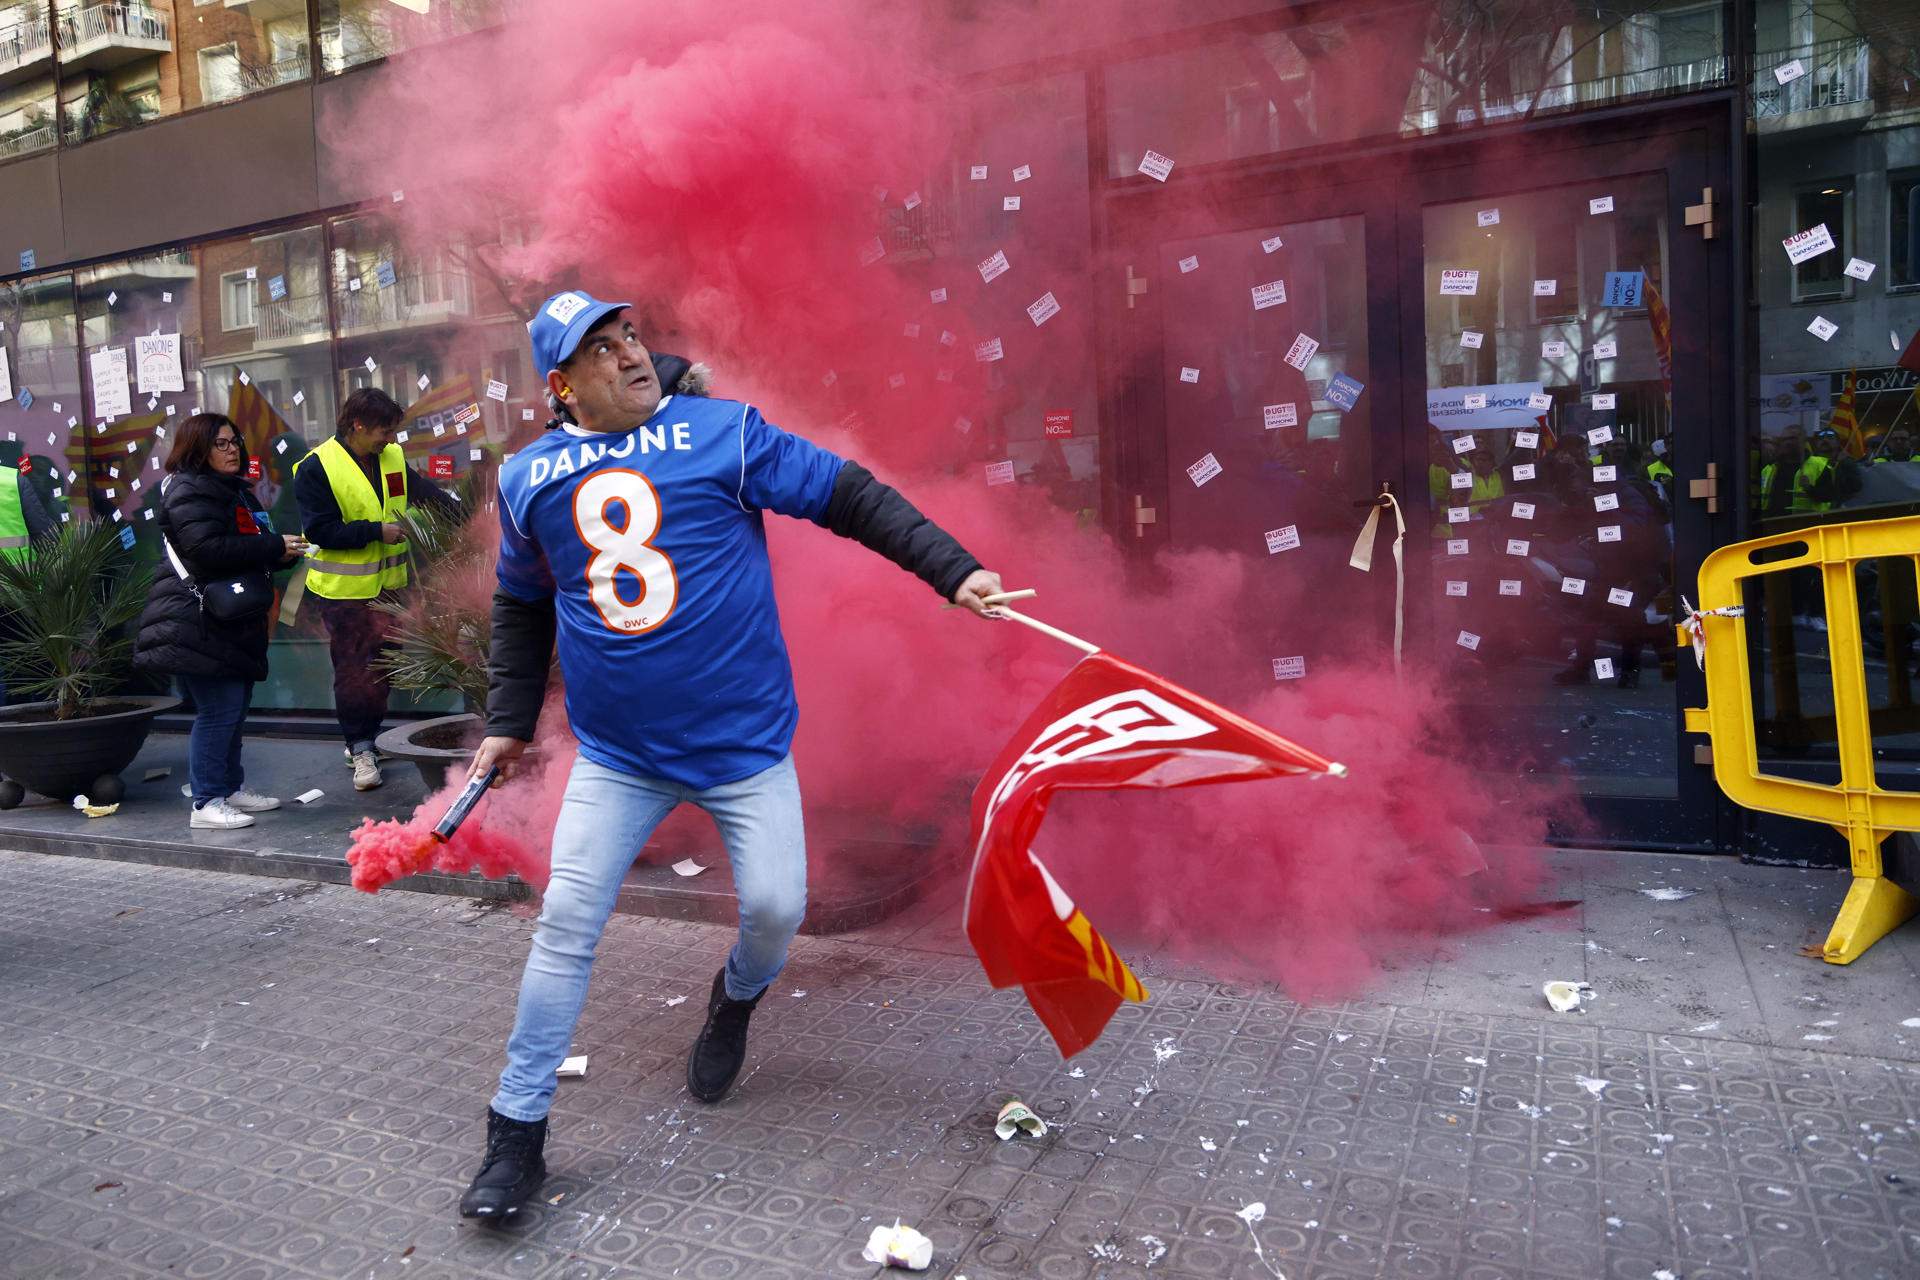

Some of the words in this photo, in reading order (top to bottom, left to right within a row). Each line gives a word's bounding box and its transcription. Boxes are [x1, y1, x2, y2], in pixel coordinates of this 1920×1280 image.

[529, 421, 692, 488] DANONE
[572, 467, 678, 635] 8
[623, 617, 649, 629] DWC
